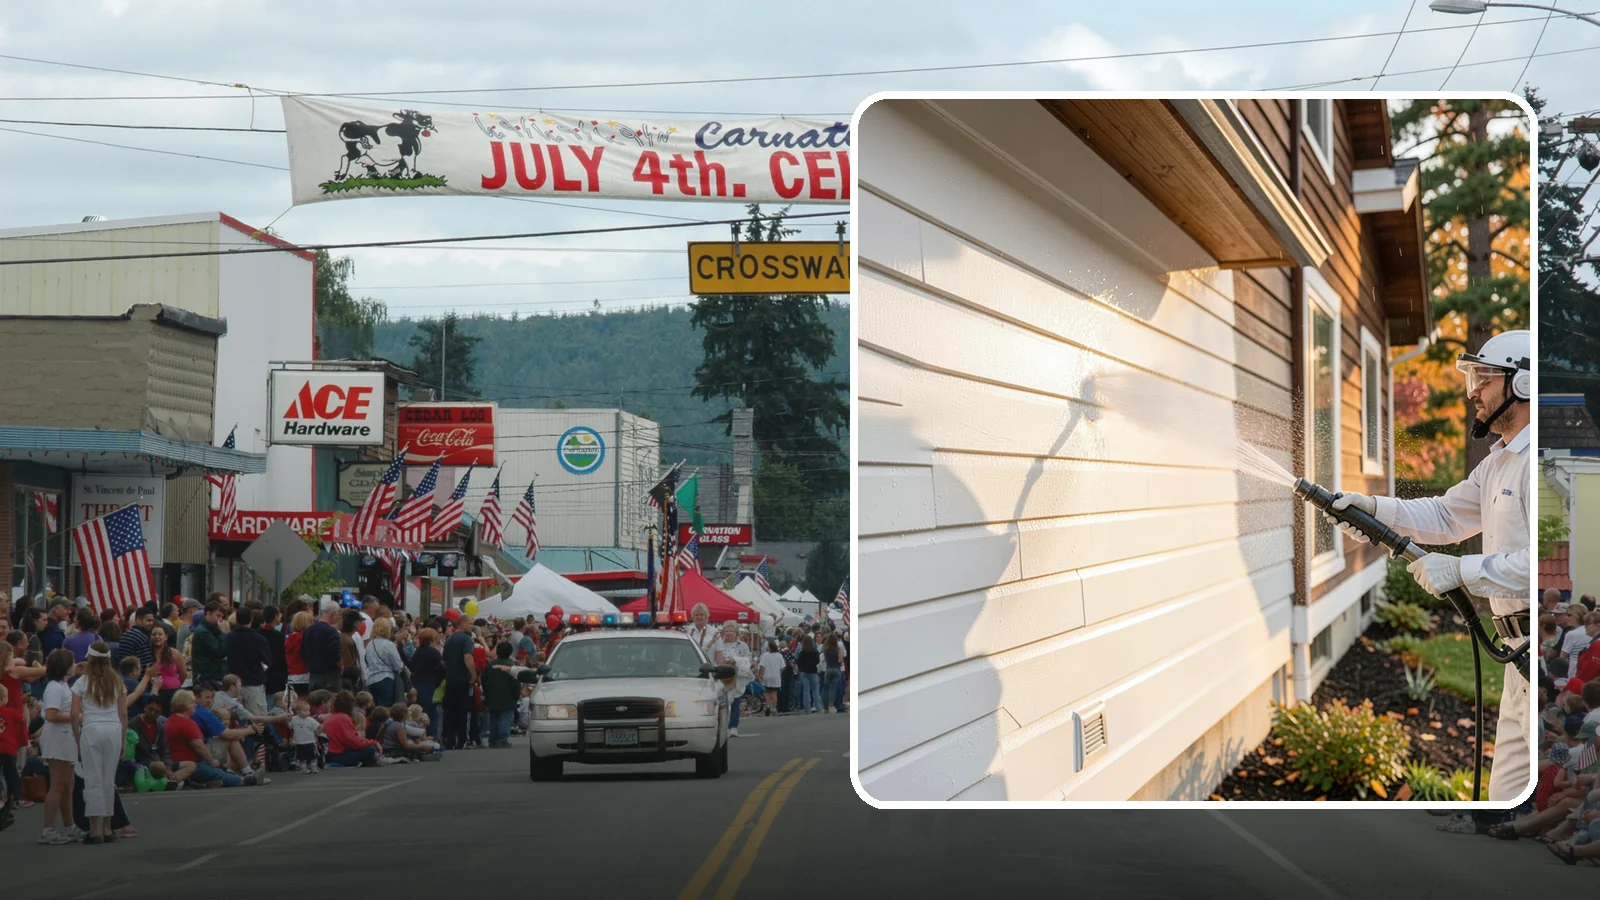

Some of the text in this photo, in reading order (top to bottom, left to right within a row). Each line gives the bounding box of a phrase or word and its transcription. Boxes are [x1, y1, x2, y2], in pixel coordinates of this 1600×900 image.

[481, 141, 604, 192] JULY
[632, 149, 746, 197] 4th.
[697, 254, 850, 280] CROSSWA
[283, 380, 373, 420] ACE
[406, 409, 485, 422] CEDAR LOG
[283, 421, 370, 436] Hardware
[416, 428, 476, 447] Coca-Cola
[83, 485, 155, 495] St. Vincent de Paul
[213, 516, 330, 535] HARDARE
[688, 526, 741, 535] CRNATION
[699, 535, 730, 543] GLASS
